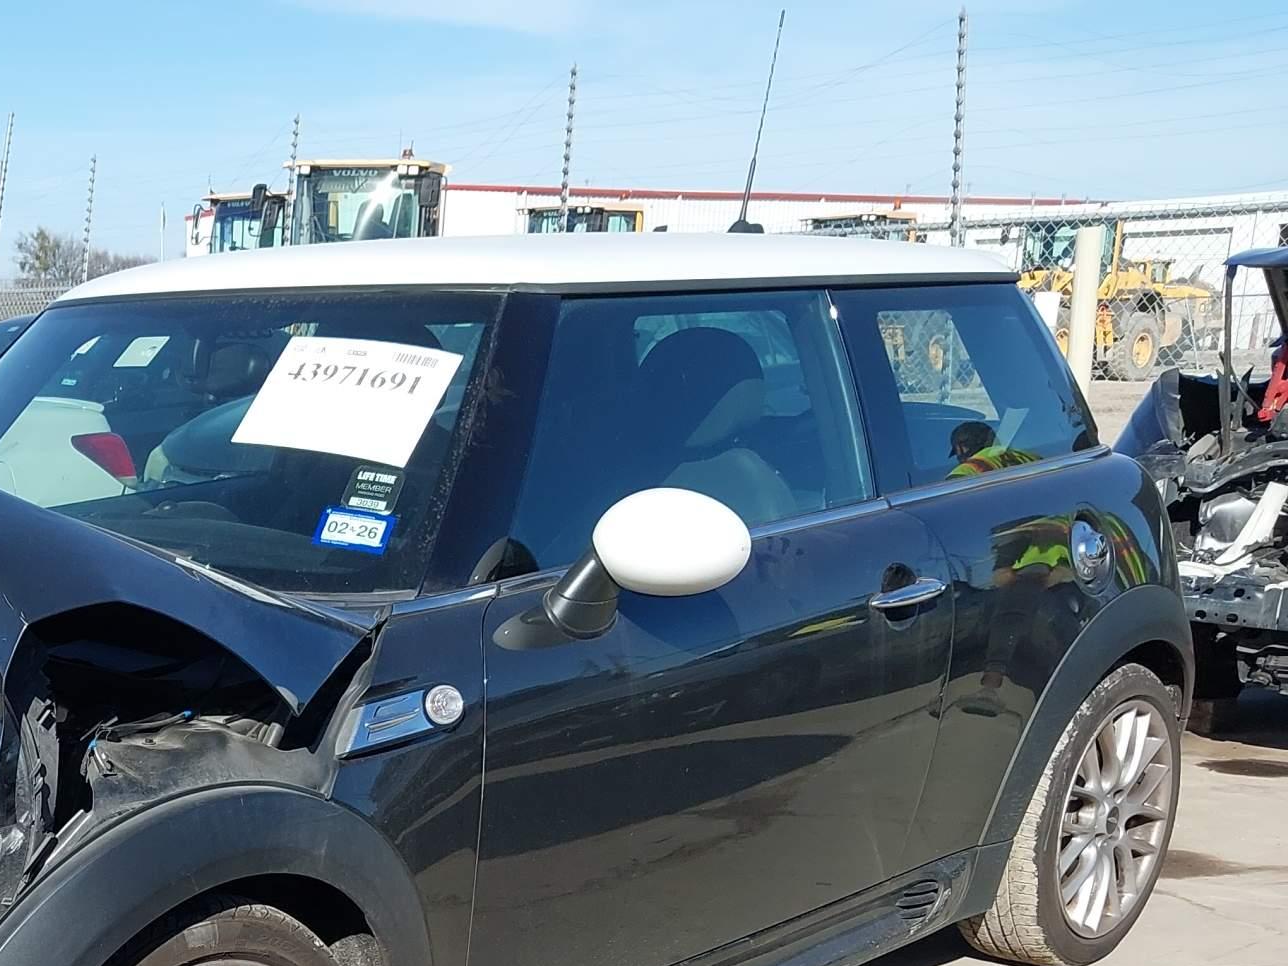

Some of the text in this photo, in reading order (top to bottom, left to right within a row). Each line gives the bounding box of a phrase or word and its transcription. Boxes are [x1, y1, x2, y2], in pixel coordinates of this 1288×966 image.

[332, 169, 378, 177] VOLVO
[288, 362, 422, 395] 43971691
[375, 473, 397, 485] TIME
[355, 482, 392, 494] MEMBER
